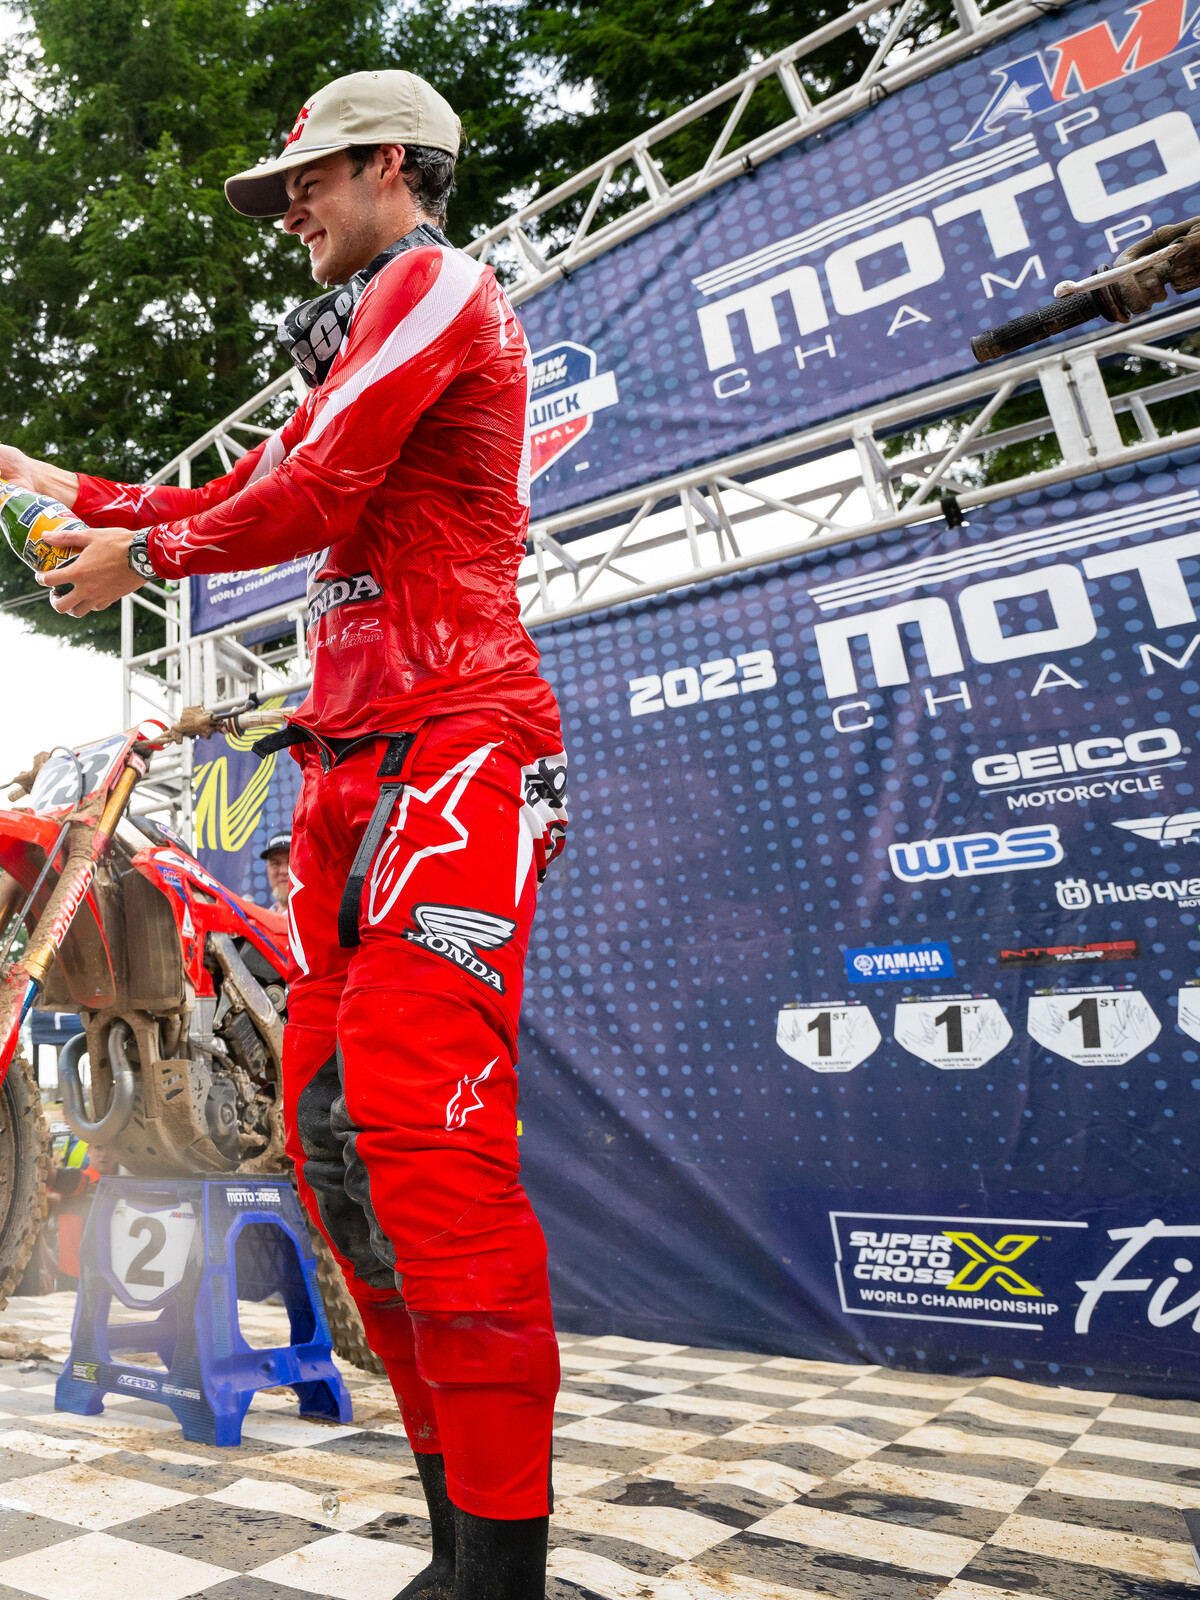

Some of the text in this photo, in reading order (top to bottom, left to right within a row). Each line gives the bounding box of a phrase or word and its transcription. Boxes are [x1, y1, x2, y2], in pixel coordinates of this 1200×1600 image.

[949, 0, 1200, 152] AM
[210, 585, 243, 605] WORLD
[308, 575, 381, 629] NDA
[629, 649, 777, 717] 2023
[972, 728, 1182, 785] GEICO
[1006, 775, 1165, 810] MOTORCYCLE
[888, 823, 1064, 883] WPS
[873, 950, 944, 970] YAMAHA
[1001, 941, 1136, 959] INTENSE
[863, 966, 940, 976] RACING
[124, 1216, 167, 1288] 2
[849, 1231, 953, 1252] SUPER
[858, 1248, 950, 1269] MOTO
[853, 1264, 956, 1286] CROSS
[1074, 1218, 1200, 1335] Fi
[860, 1288, 1059, 1316] WORLD CHAMPIONSHIP
